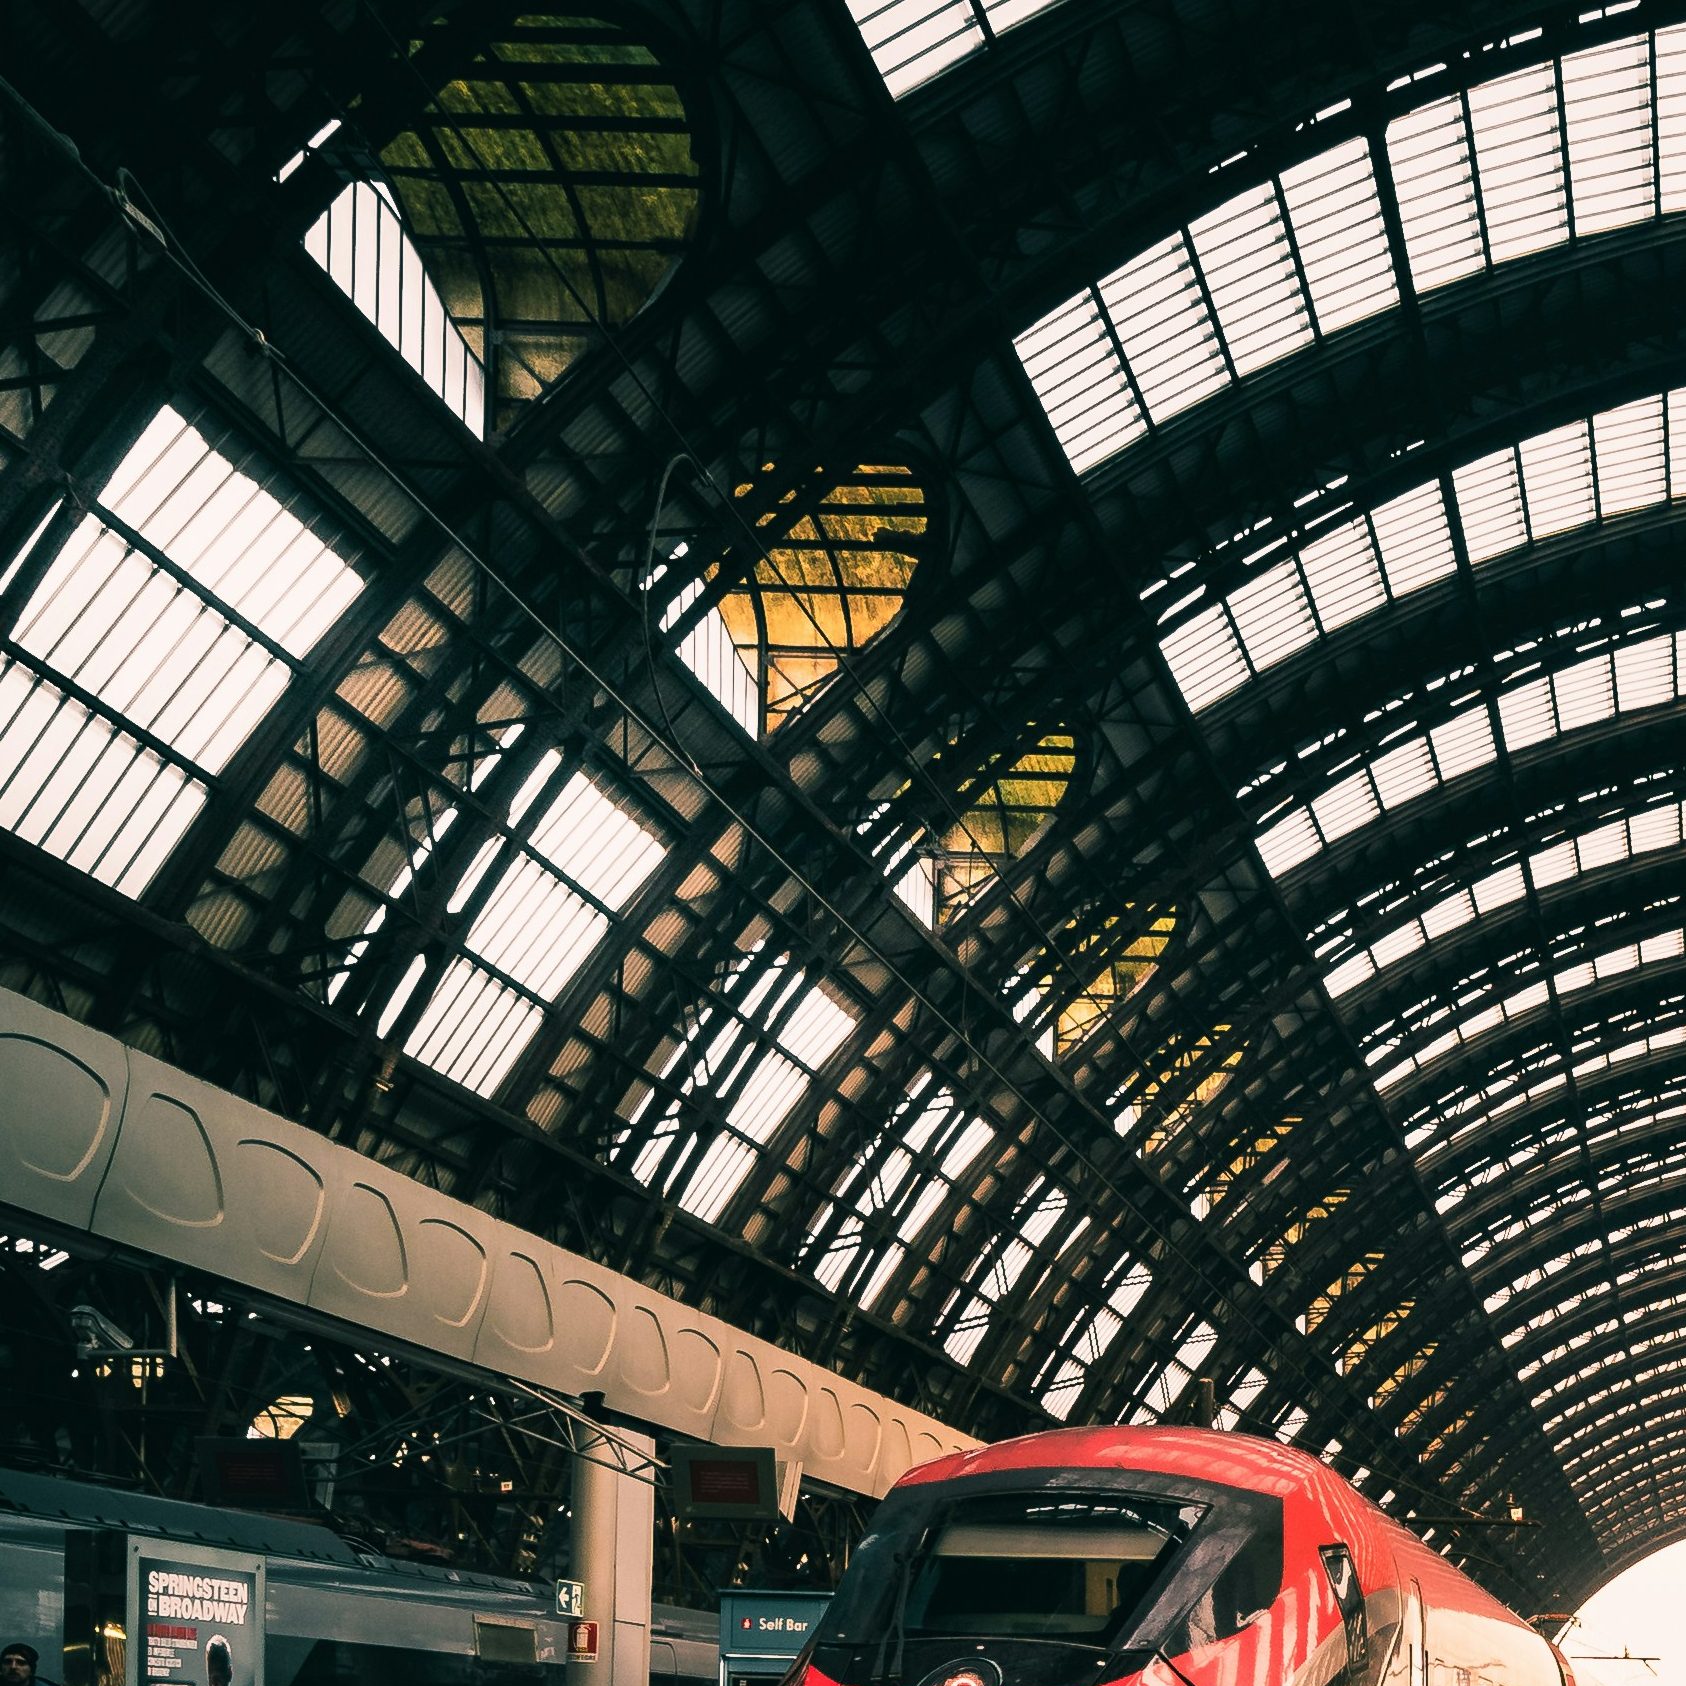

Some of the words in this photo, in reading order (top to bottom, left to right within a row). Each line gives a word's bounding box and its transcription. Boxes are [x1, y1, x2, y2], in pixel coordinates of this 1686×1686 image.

[149, 1571, 248, 1604] SPRINGSTEEN
[159, 1595, 248, 1625] BROADWAY
[759, 1617, 784, 1631] Self
[786, 1618, 809, 1632] Bar
